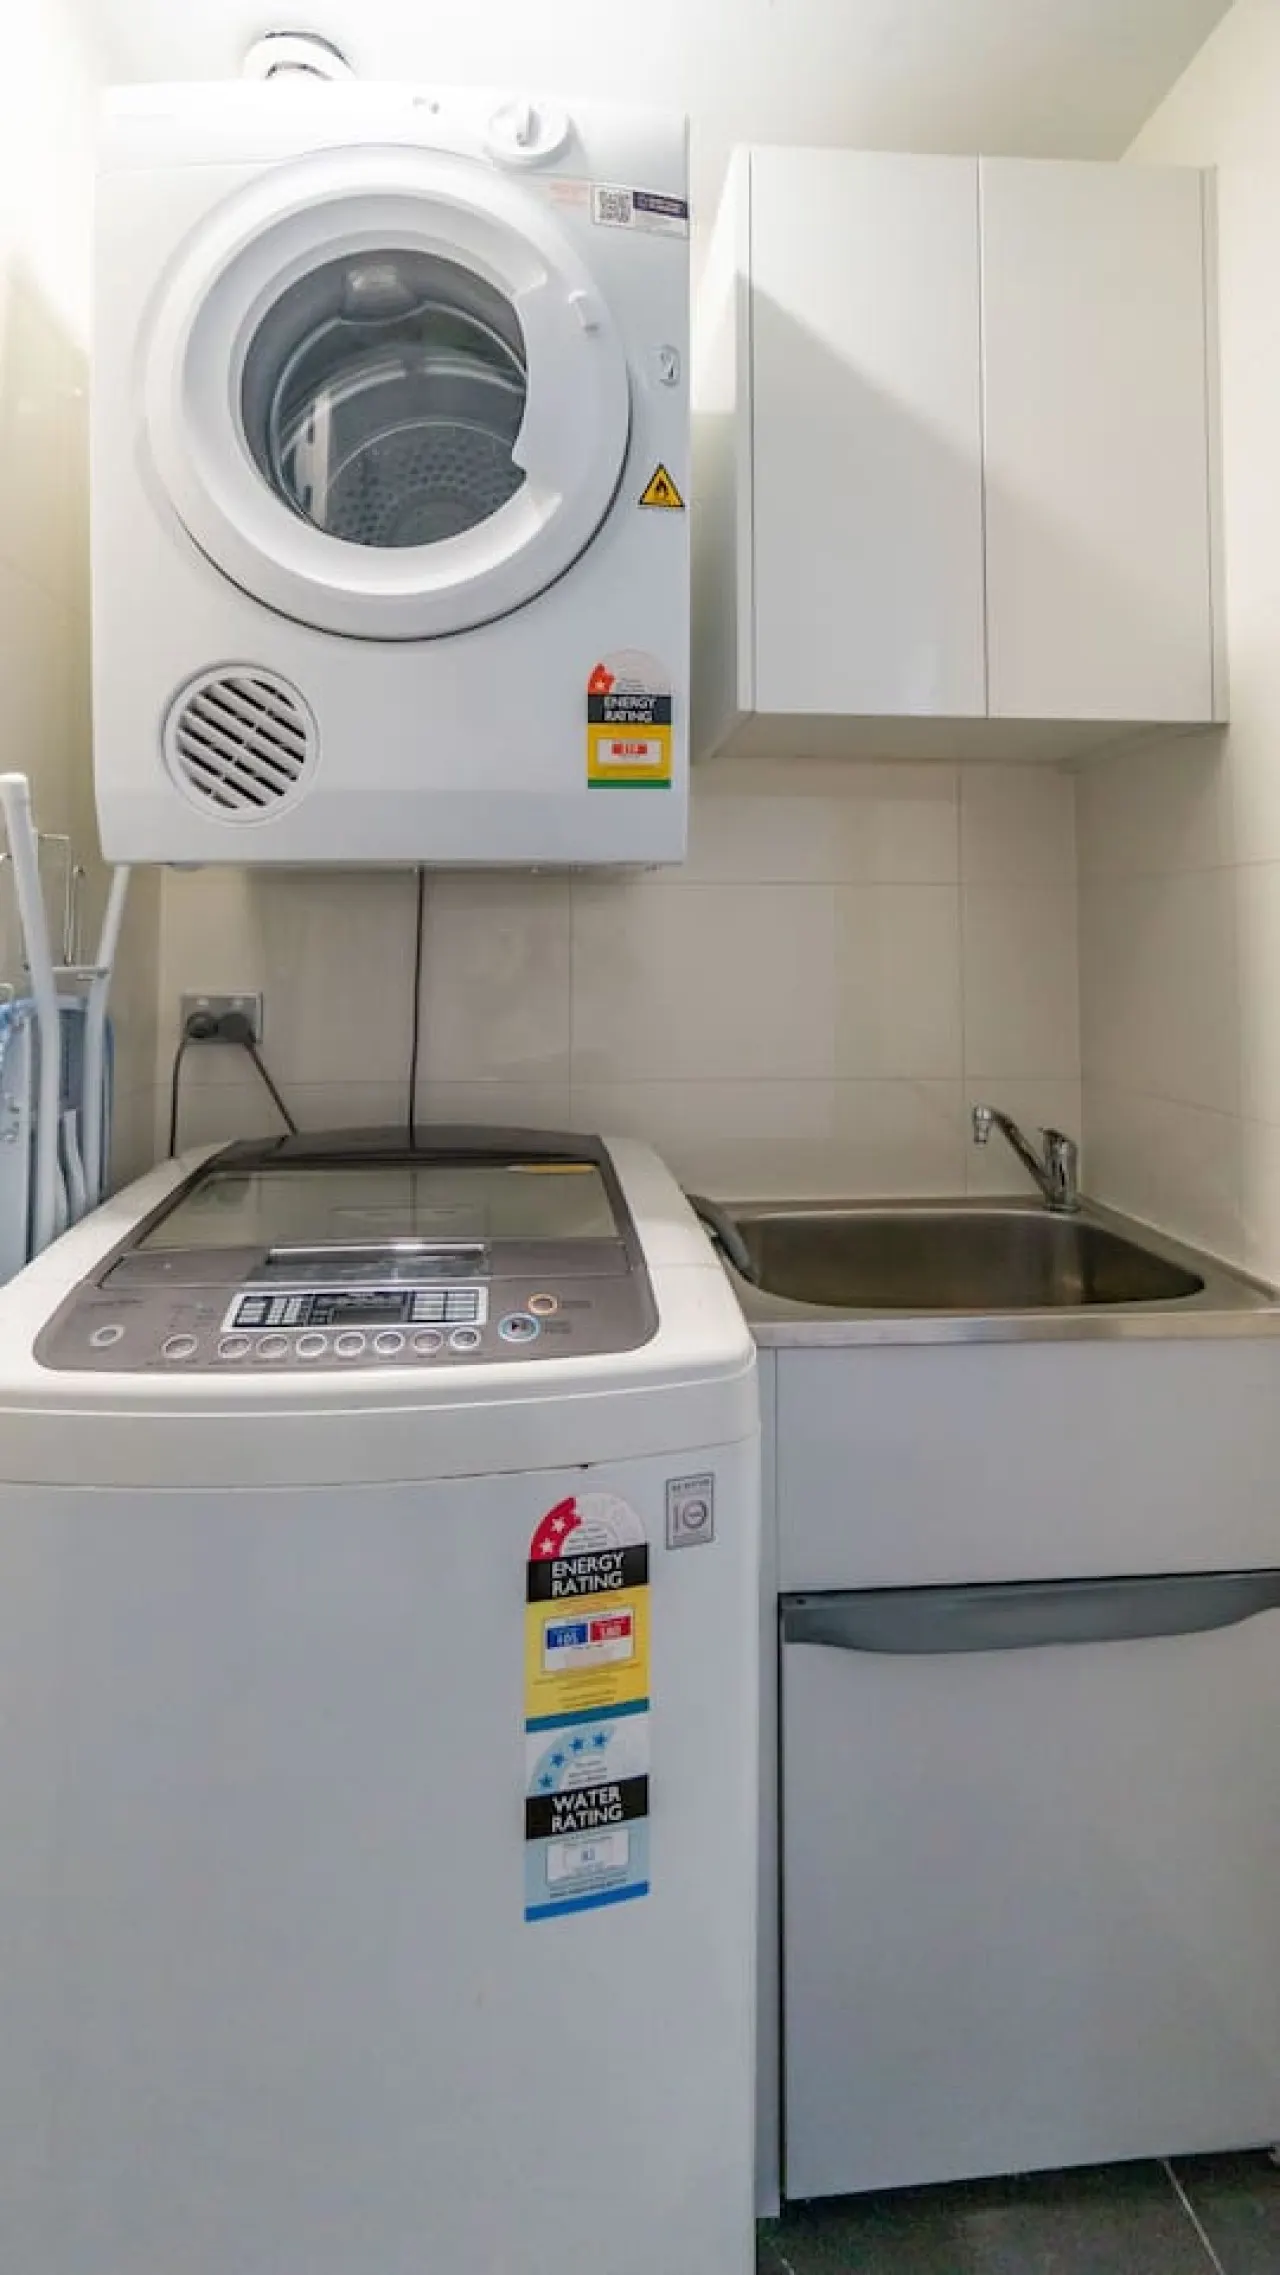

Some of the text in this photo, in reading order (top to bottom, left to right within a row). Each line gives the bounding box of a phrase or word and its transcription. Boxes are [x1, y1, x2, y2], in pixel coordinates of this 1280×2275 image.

[603, 696, 655, 709] ENERGY
[604, 710, 653, 722] RATING
[552, 1552, 624, 1578] ENERGY
[551, 1570, 623, 1597] RATING
[551, 1786, 622, 1813] WATER
[551, 1805, 623, 1833] RATING
